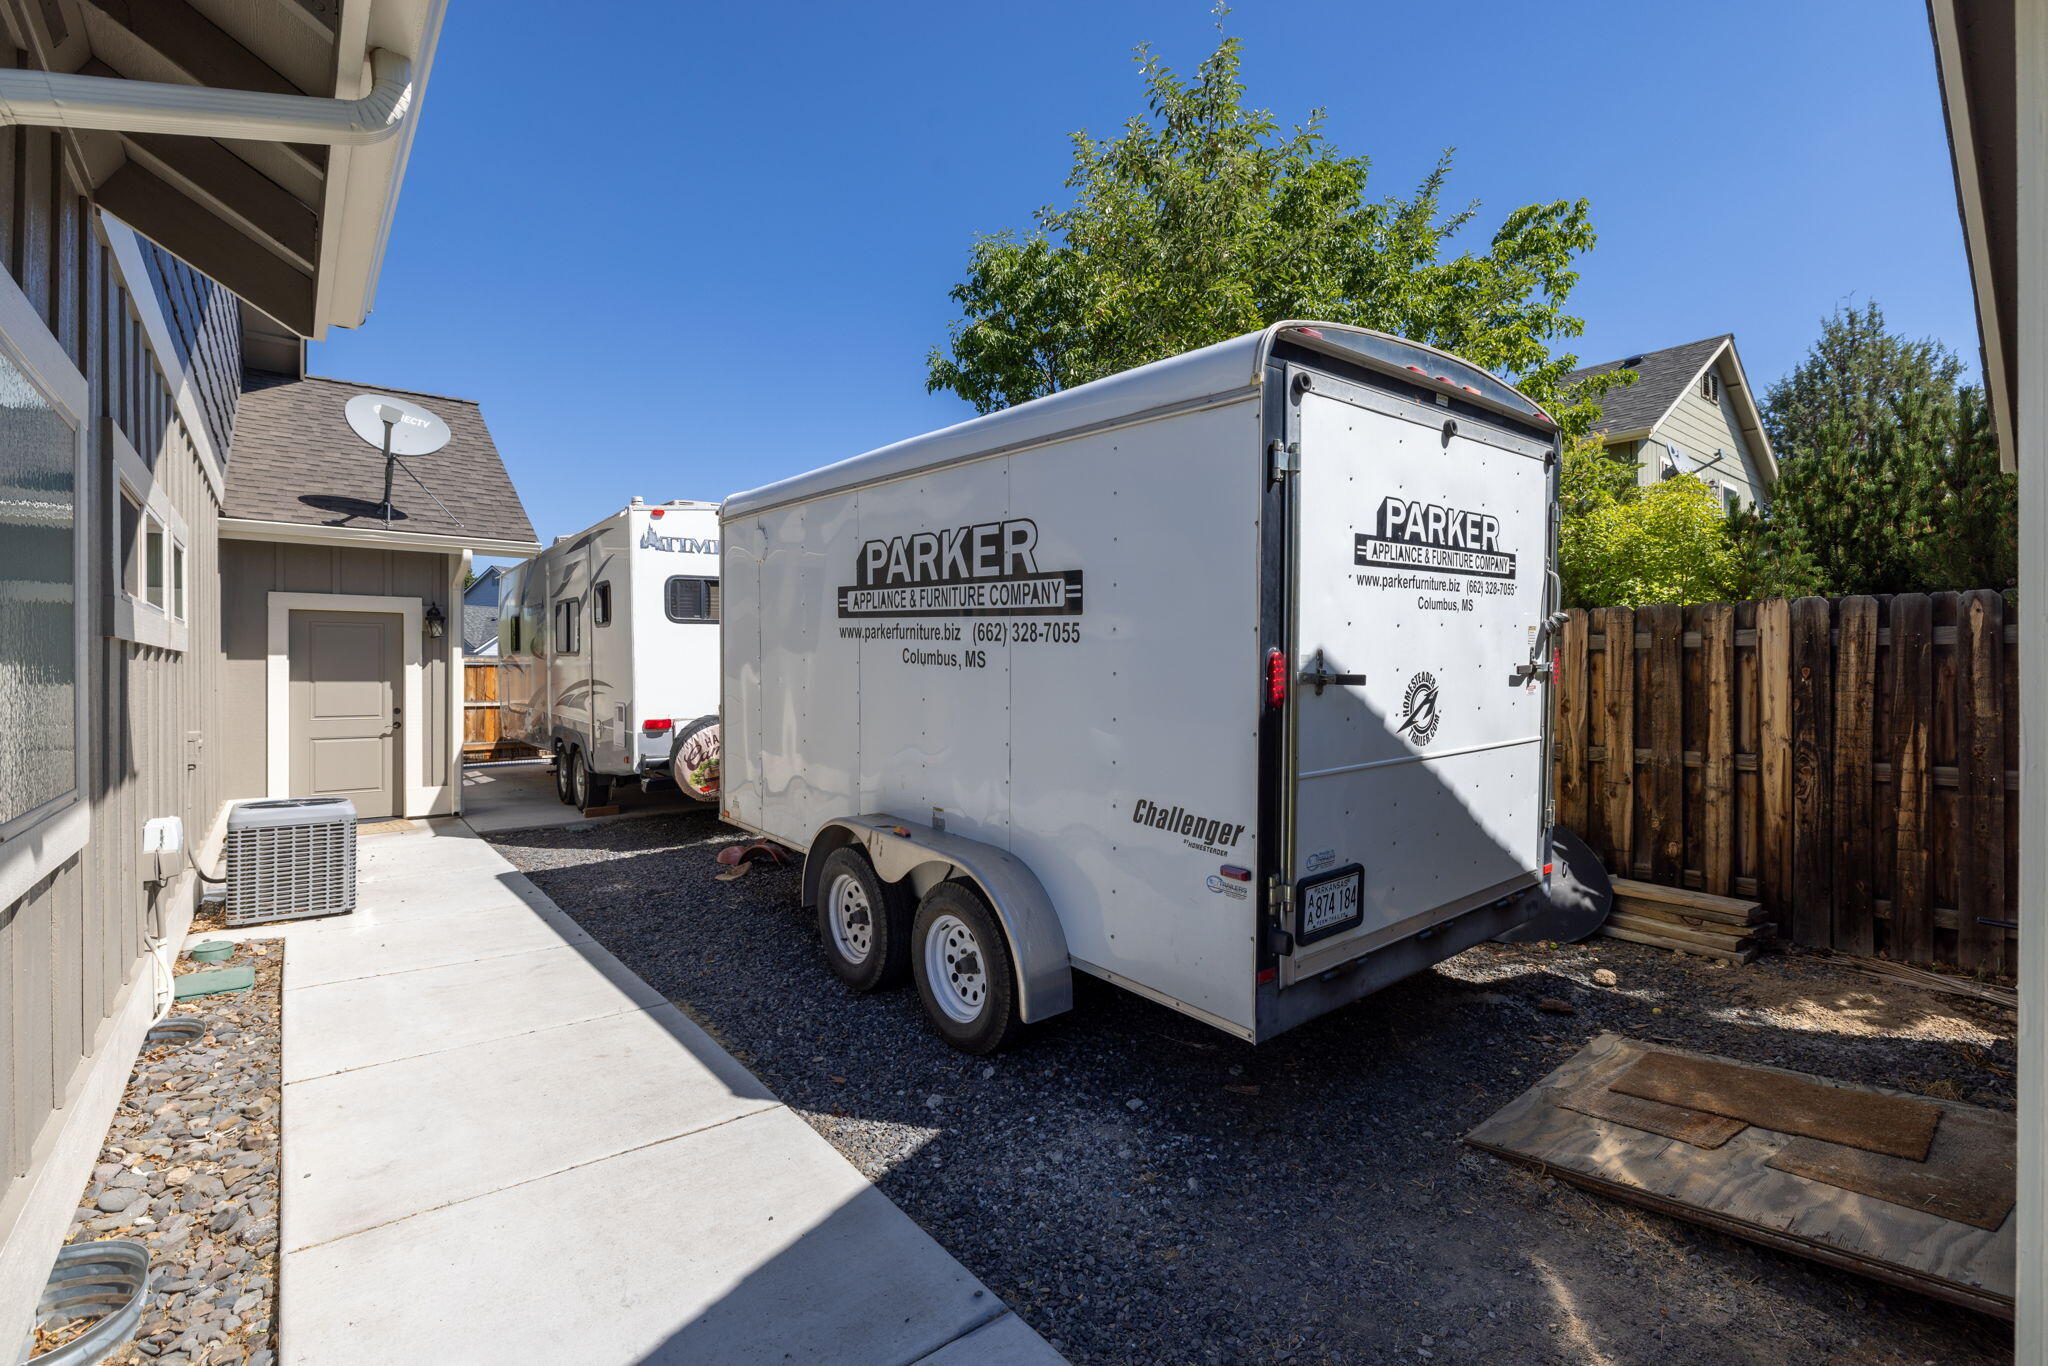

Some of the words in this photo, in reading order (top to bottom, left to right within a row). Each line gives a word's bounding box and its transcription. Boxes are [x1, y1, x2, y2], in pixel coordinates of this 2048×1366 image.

[1376, 496, 1500, 552] PARKER
[857, 518, 1038, 587] PARKER
[1371, 542, 1423, 564] APPLIANCE
[1424, 548, 1431, 564] &
[1432, 551, 1474, 569] FURNITURE
[1475, 556, 1509, 572] COMPANY
[852, 589, 907, 610] APPLIANCE
[909, 589, 917, 609] &
[920, 584, 984, 608] FURNITURE
[990, 581, 1062, 606] COMPANY
[1356, 573, 1461, 593] www.parkerfurniture.biz
[1466, 579, 1484, 597] (662)
[1485, 581, 1515, 596] 328-7055
[1418, 596, 1460, 613] Columbus,
[1461, 598, 1474, 612] MS
[839, 622, 961, 643] www.parkerfurniture.biz
[972, 622, 1008, 647] (662)
[1012, 621, 1081, 644] 328-7055
[902, 648, 962, 671] Columbus,
[965, 650, 986, 669] MS
[1403, 671, 1436, 717] HOMESTEADER
[1133, 799, 1246, 847] Challenger
[1316, 892, 1335, 919] 874
[1339, 885, 1357, 912] 184
